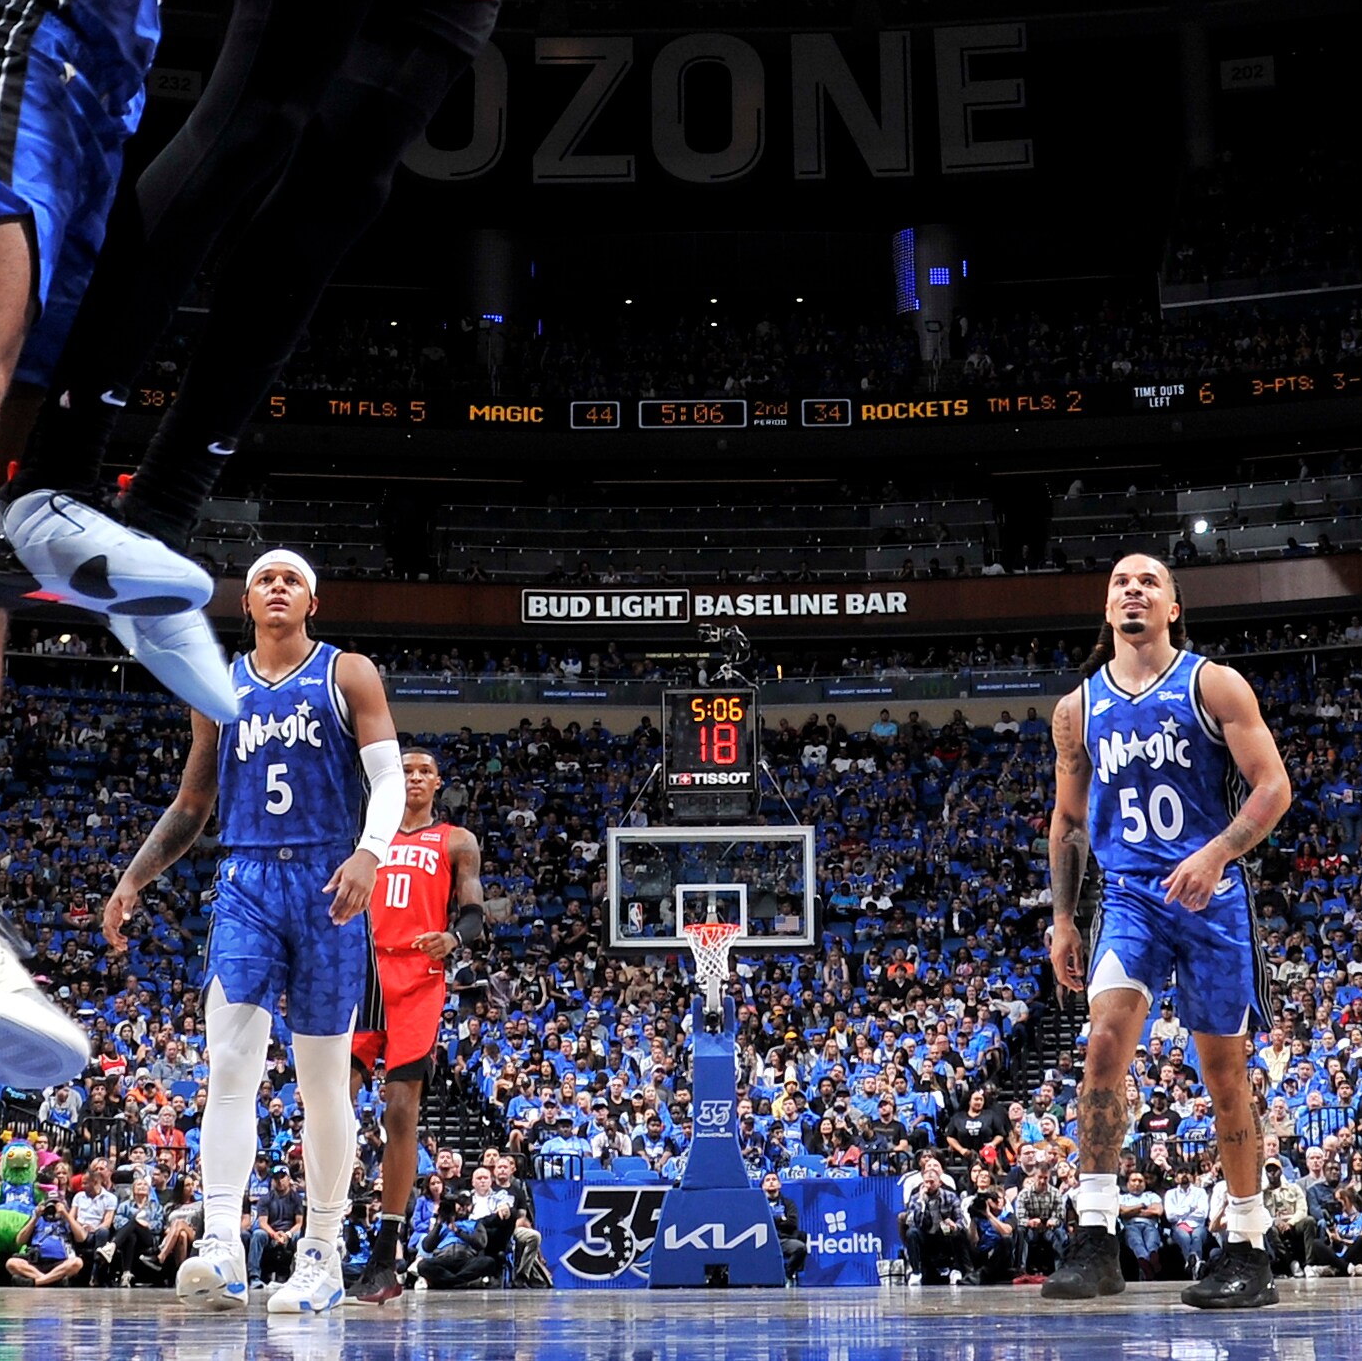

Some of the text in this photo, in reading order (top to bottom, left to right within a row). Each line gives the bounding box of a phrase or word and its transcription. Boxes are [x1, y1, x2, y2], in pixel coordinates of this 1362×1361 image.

[159, 76, 191, 91] 232
[1231, 65, 1264, 80] 202
[329, 400, 351, 416] TM
[358, 401, 397, 418] FLS:
[410, 401, 427, 421] 5
[469, 404, 544, 423] MAGIC
[586, 405, 613, 423] 44
[661, 404, 725, 424] 5:06
[753, 401, 789, 416] 2nd
[814, 403, 841, 421] 34
[861, 399, 969, 421] ROCKETS
[986, 397, 1010, 414] TM
[1018, 395, 1057, 412] FLS:
[1065, 390, 1082, 412] 2
[1133, 386, 1157, 399] TIME
[1159, 384, 1185, 397] OUTS
[1199, 382, 1215, 405] 6
[1149, 396, 1171, 408] LEFT
[753, 418, 788, 426] PERIOD
[528, 592, 907, 617] BUD LIGHT BASELINE BAR
[691, 698, 743, 722] 5:06
[700, 723, 737, 765] 18
[265, 763, 293, 815] 5
[691, 772, 751, 785] TISSOT
[1119, 784, 1184, 843] 50
[386, 873, 411, 908] 10
[806, 1232, 882, 1254] Health
